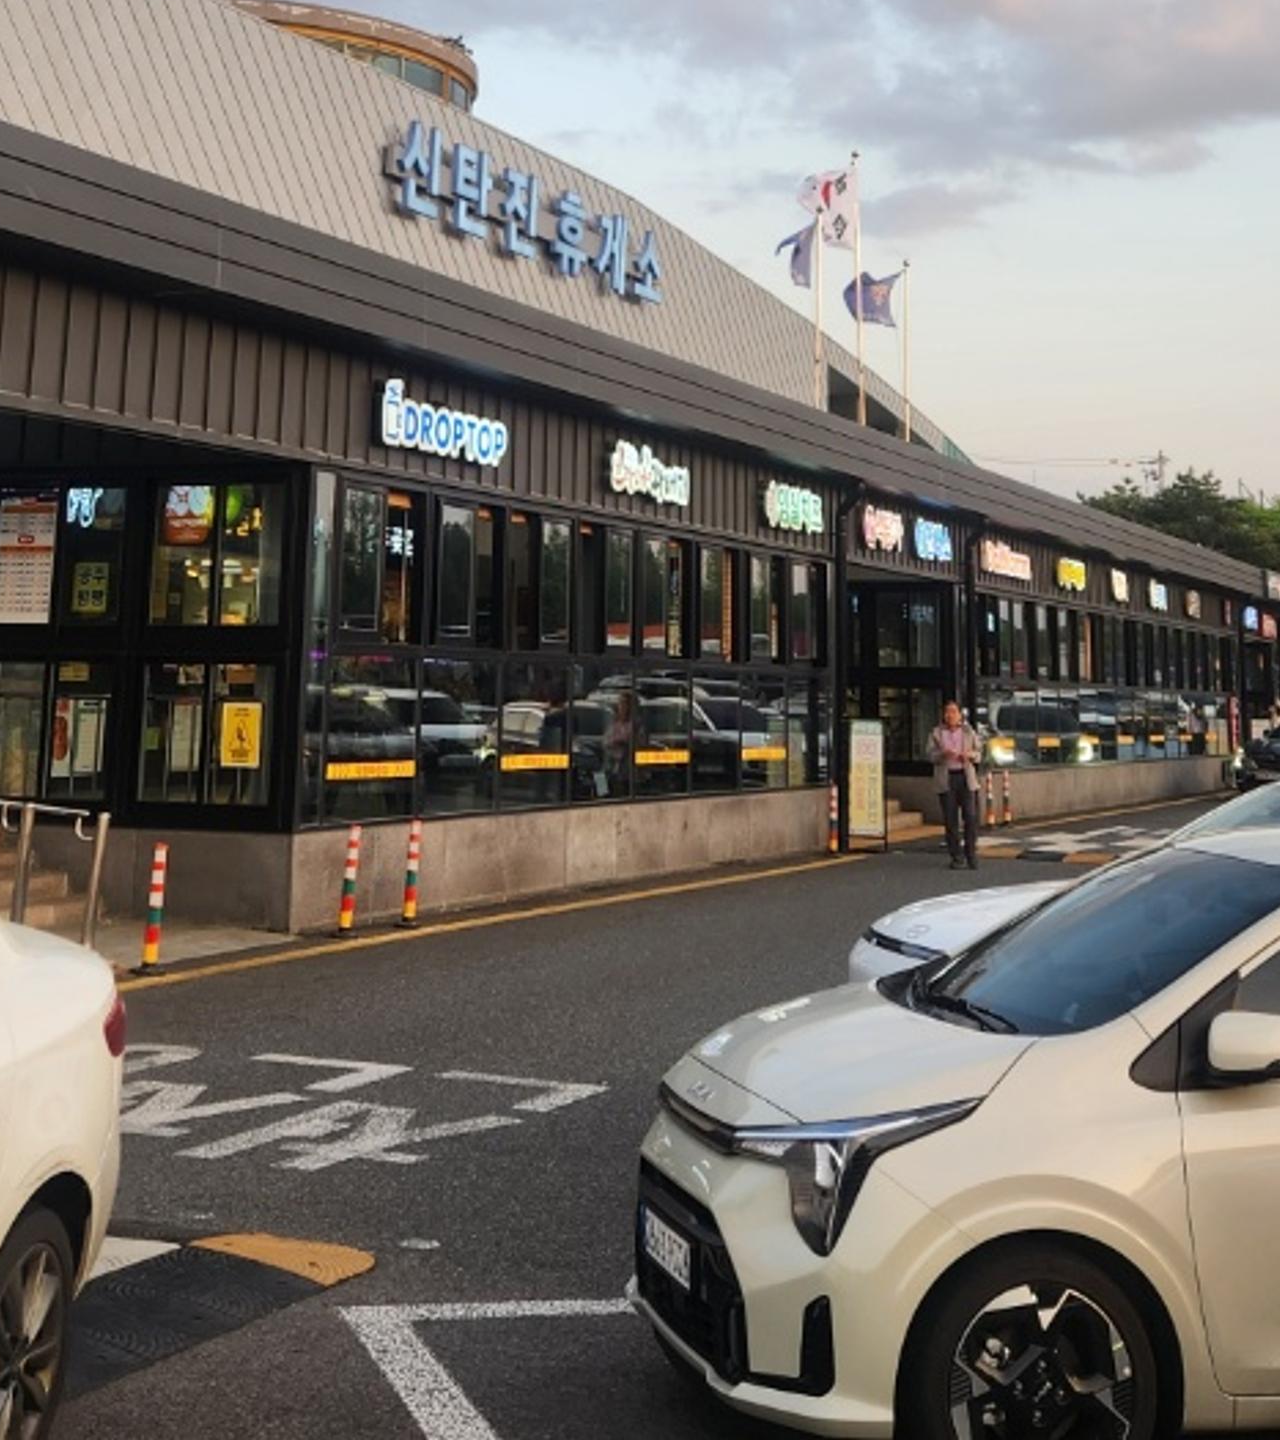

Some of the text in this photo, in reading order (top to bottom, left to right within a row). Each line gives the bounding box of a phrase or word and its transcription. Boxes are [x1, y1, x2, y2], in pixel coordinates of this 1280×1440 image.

[394, 120, 665, 305] 신탄진 휴게소
[402, 404, 506, 461] DROPTOP
